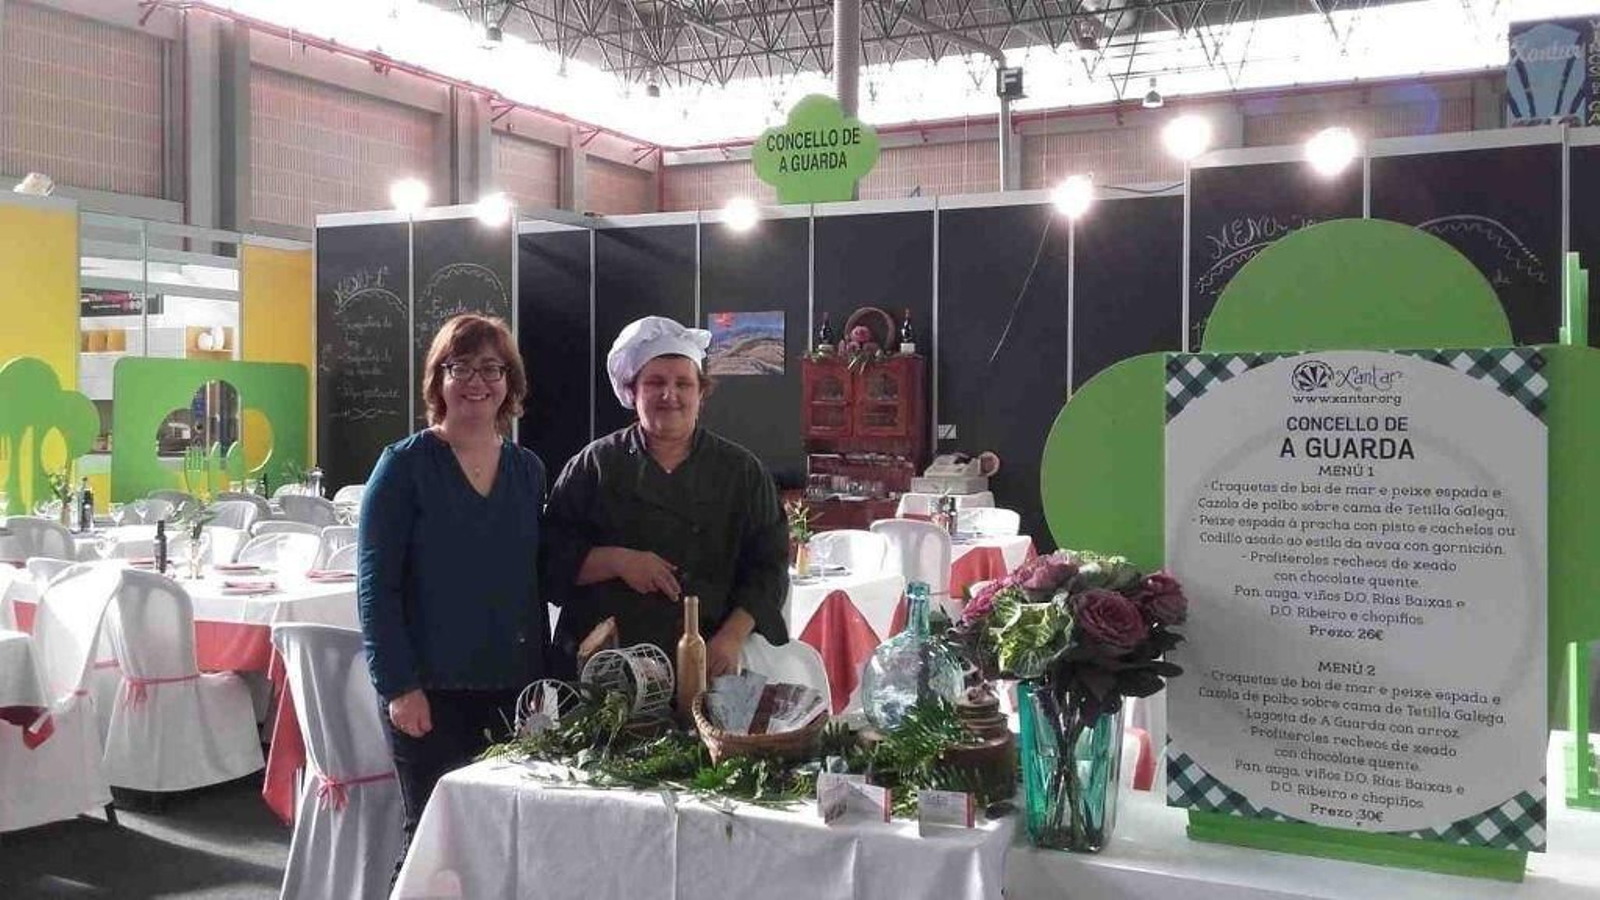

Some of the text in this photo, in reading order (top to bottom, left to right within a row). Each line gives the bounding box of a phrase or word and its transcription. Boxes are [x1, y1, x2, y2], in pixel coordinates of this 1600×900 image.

[1000, 70, 1018, 93] F
[766, 127, 861, 152] CONCELLO DE
[779, 151, 848, 173] A GUARDA
[1335, 365, 1403, 392] Xantar
[1286, 416, 1408, 432] CONCELLO DE
[1279, 437, 1415, 460] A GUARDA
[1318, 463, 1375, 477] MENÚ 1
[1211, 480, 1501, 501] Croquetas de boi de mar e peixe espada e
[1198, 497, 1239, 510] Cazola
[1242, 498, 1259, 510] de
[1262, 499, 1298, 513] polbo
[1301, 500, 1339, 512] sobre
[1343, 503, 1381, 514] cama
[1385, 503, 1402, 514] de
[1407, 503, 1450, 517] Tetilla
[1199, 514, 1234, 527] Peixe
[1238, 517, 1285, 531] espada
[1354, 521, 1377, 532] con
[1382, 521, 1415, 535] pisto
[1418, 524, 1428, 534] e
[1497, 526, 1516, 537] ou
[1199, 531, 1242, 545] Codillo
[1245, 533, 1283, 545] asado
[1287, 536, 1302, 546] ao
[1345, 537, 1362, 549] da
[1404, 542, 1429, 552] con
[1333, 554, 1387, 568] recheos
[1391, 557, 1409, 569] de
[1413, 560, 1457, 572] xeado
[1274, 572, 1297, 582] con
[1301, 570, 1365, 585] chocolate
[1405, 595, 1453, 608] Baixas
[1297, 606, 1346, 620] Ribeiro
[1350, 611, 1358, 621] e
[1357, 628, 1384, 641] 26€
[1318, 661, 1376, 677] MENÚ 2
[1211, 670, 1501, 705] Croquetas de boi de mar e peixe espada e
[1242, 690, 1259, 701] de
[1263, 693, 1298, 707] polbo
[1302, 695, 1340, 710] sobre
[1343, 700, 1381, 713] cama
[1385, 702, 1402, 715] de
[1407, 704, 1450, 720] Tetilla
[1247, 708, 1296, 723] Lagosta
[1300, 713, 1317, 726] de
[1321, 715, 1331, 726] A
[1334, 717, 1385, 732] Guarda
[1389, 724, 1414, 735] con
[1333, 735, 1388, 751] recheos
[1391, 740, 1409, 752] de
[1413, 745, 1457, 757] xeado
[1274, 748, 1297, 759] con
[1301, 748, 1365, 765] chocolate
[1298, 783, 1347, 800] Ribeiro
[1350, 791, 1359, 801] e
[1405, 778, 1452, 794] Baixas
[1456, 785, 1465, 795] e
